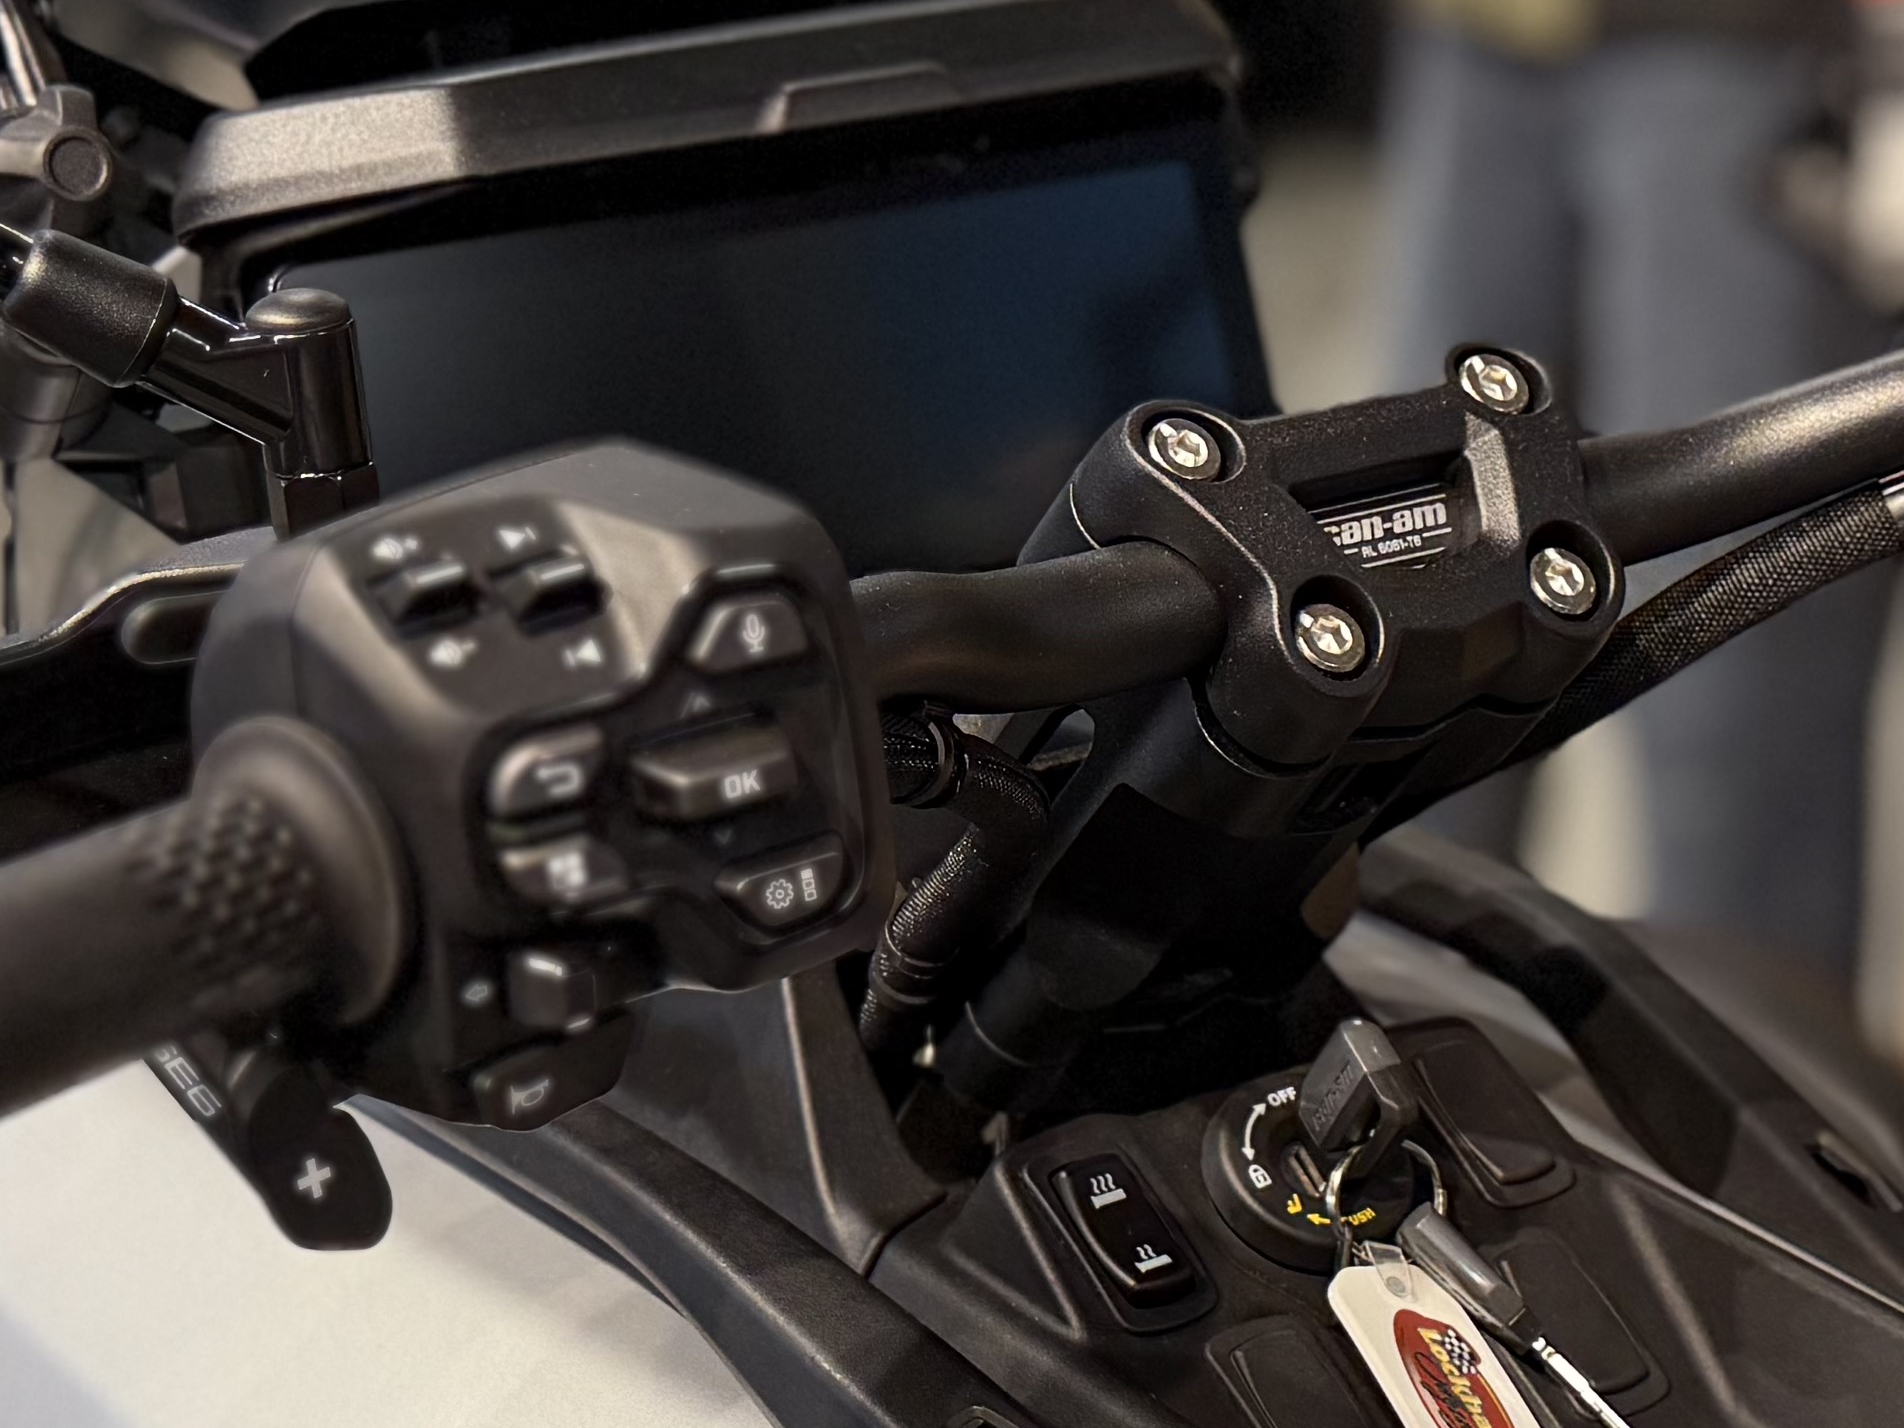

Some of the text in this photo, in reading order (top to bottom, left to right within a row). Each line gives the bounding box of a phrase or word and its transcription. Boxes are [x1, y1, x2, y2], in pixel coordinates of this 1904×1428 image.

[724, 769, 761, 799] OK
[1267, 1086, 1297, 1107] OFF
[1341, 1207, 1376, 1226] USH
